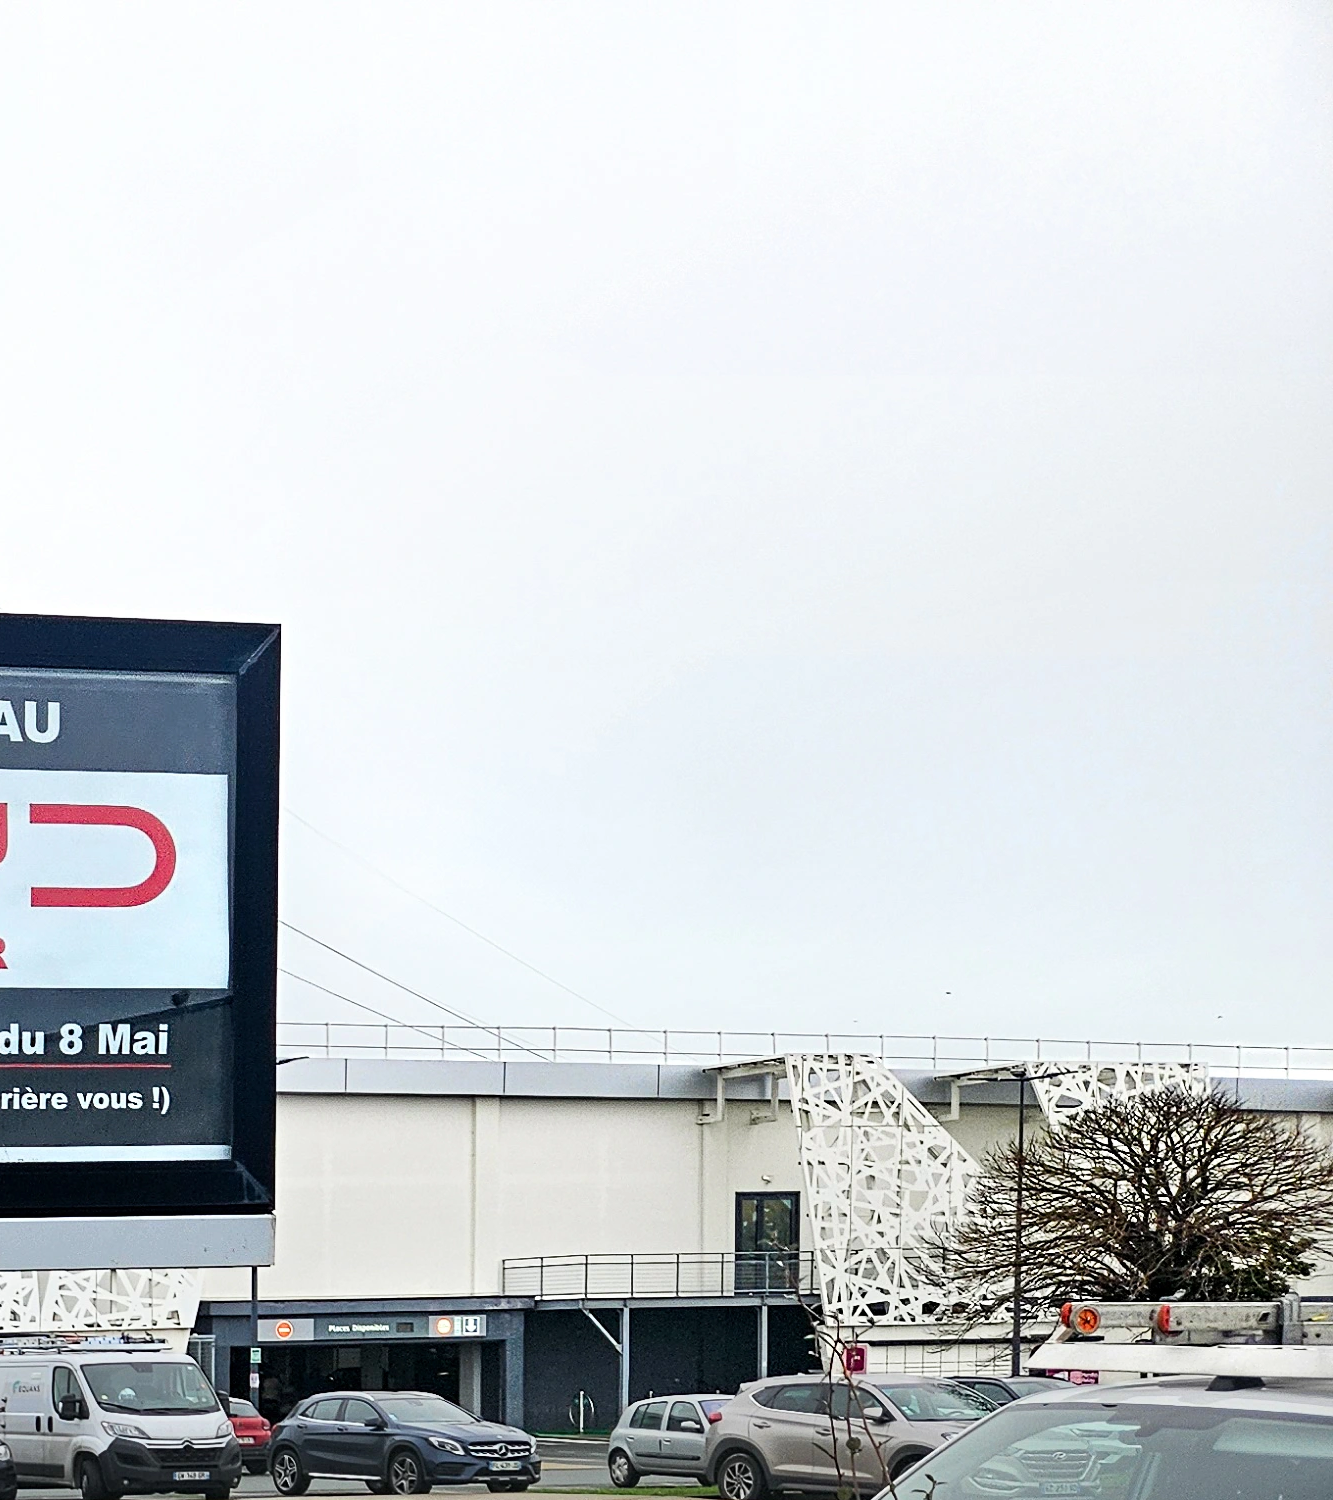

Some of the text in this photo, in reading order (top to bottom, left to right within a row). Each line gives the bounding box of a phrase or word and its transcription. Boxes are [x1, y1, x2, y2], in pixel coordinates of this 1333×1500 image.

[58, 1023, 83, 1056] 8
[97, 1022, 169, 1055] Mai
[76, 1091, 143, 1111] vous
[151, 1086, 171, 1115] !)
